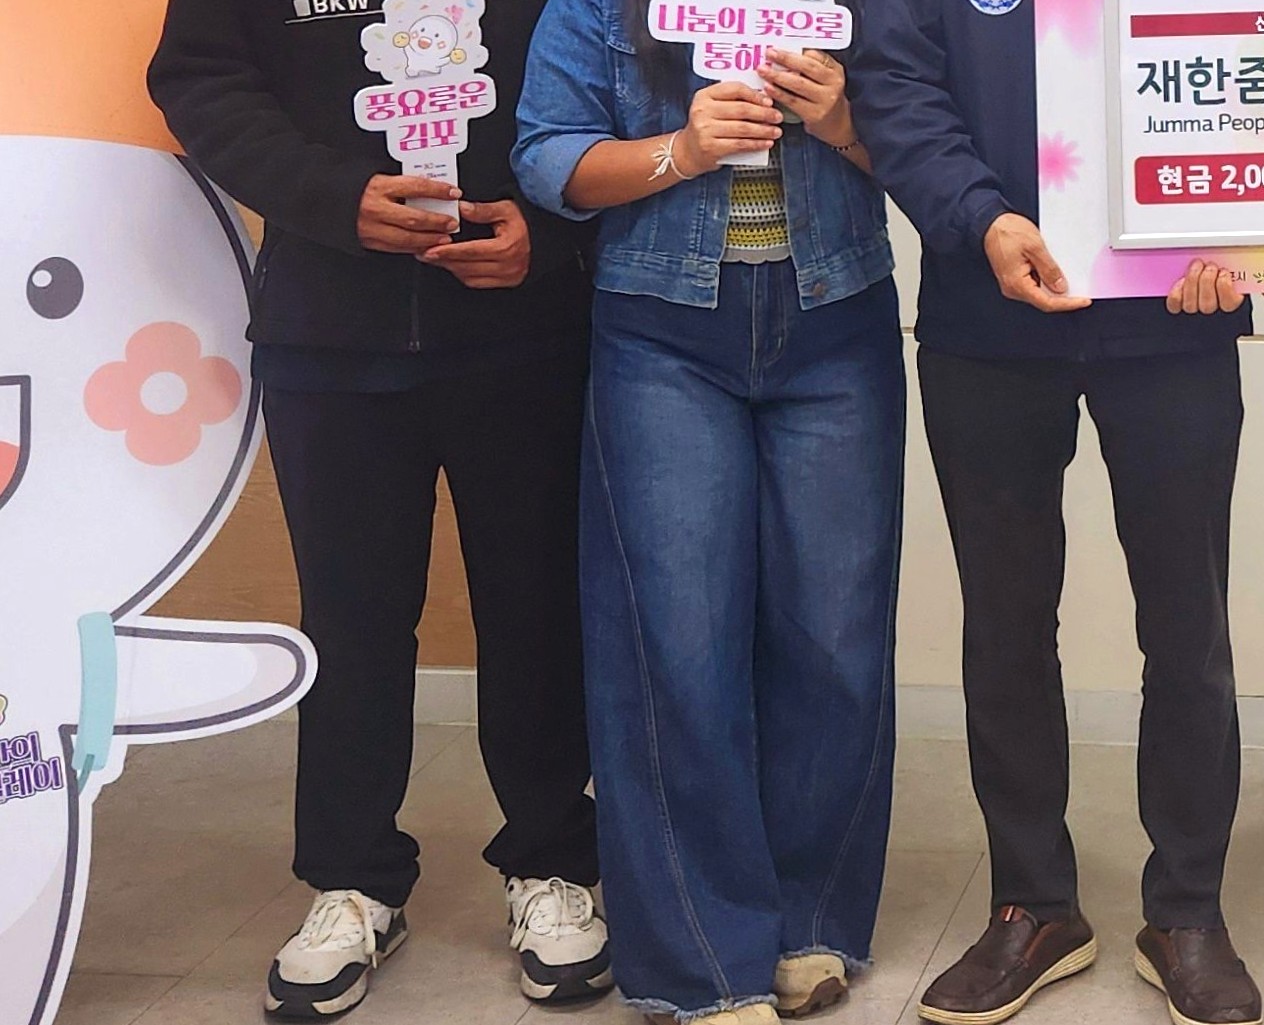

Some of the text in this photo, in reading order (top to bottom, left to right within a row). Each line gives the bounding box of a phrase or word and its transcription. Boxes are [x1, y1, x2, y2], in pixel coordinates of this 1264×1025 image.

[658, 4, 844, 39] 나눔의 꽃으로
[704, 42, 774, 71] 통하
[366, 80, 488, 122] 풍요로운
[398, 118, 460, 153] 김포
[1143, 115, 1214, 134] Jumma
[1157, 164, 1213, 195] 현금
